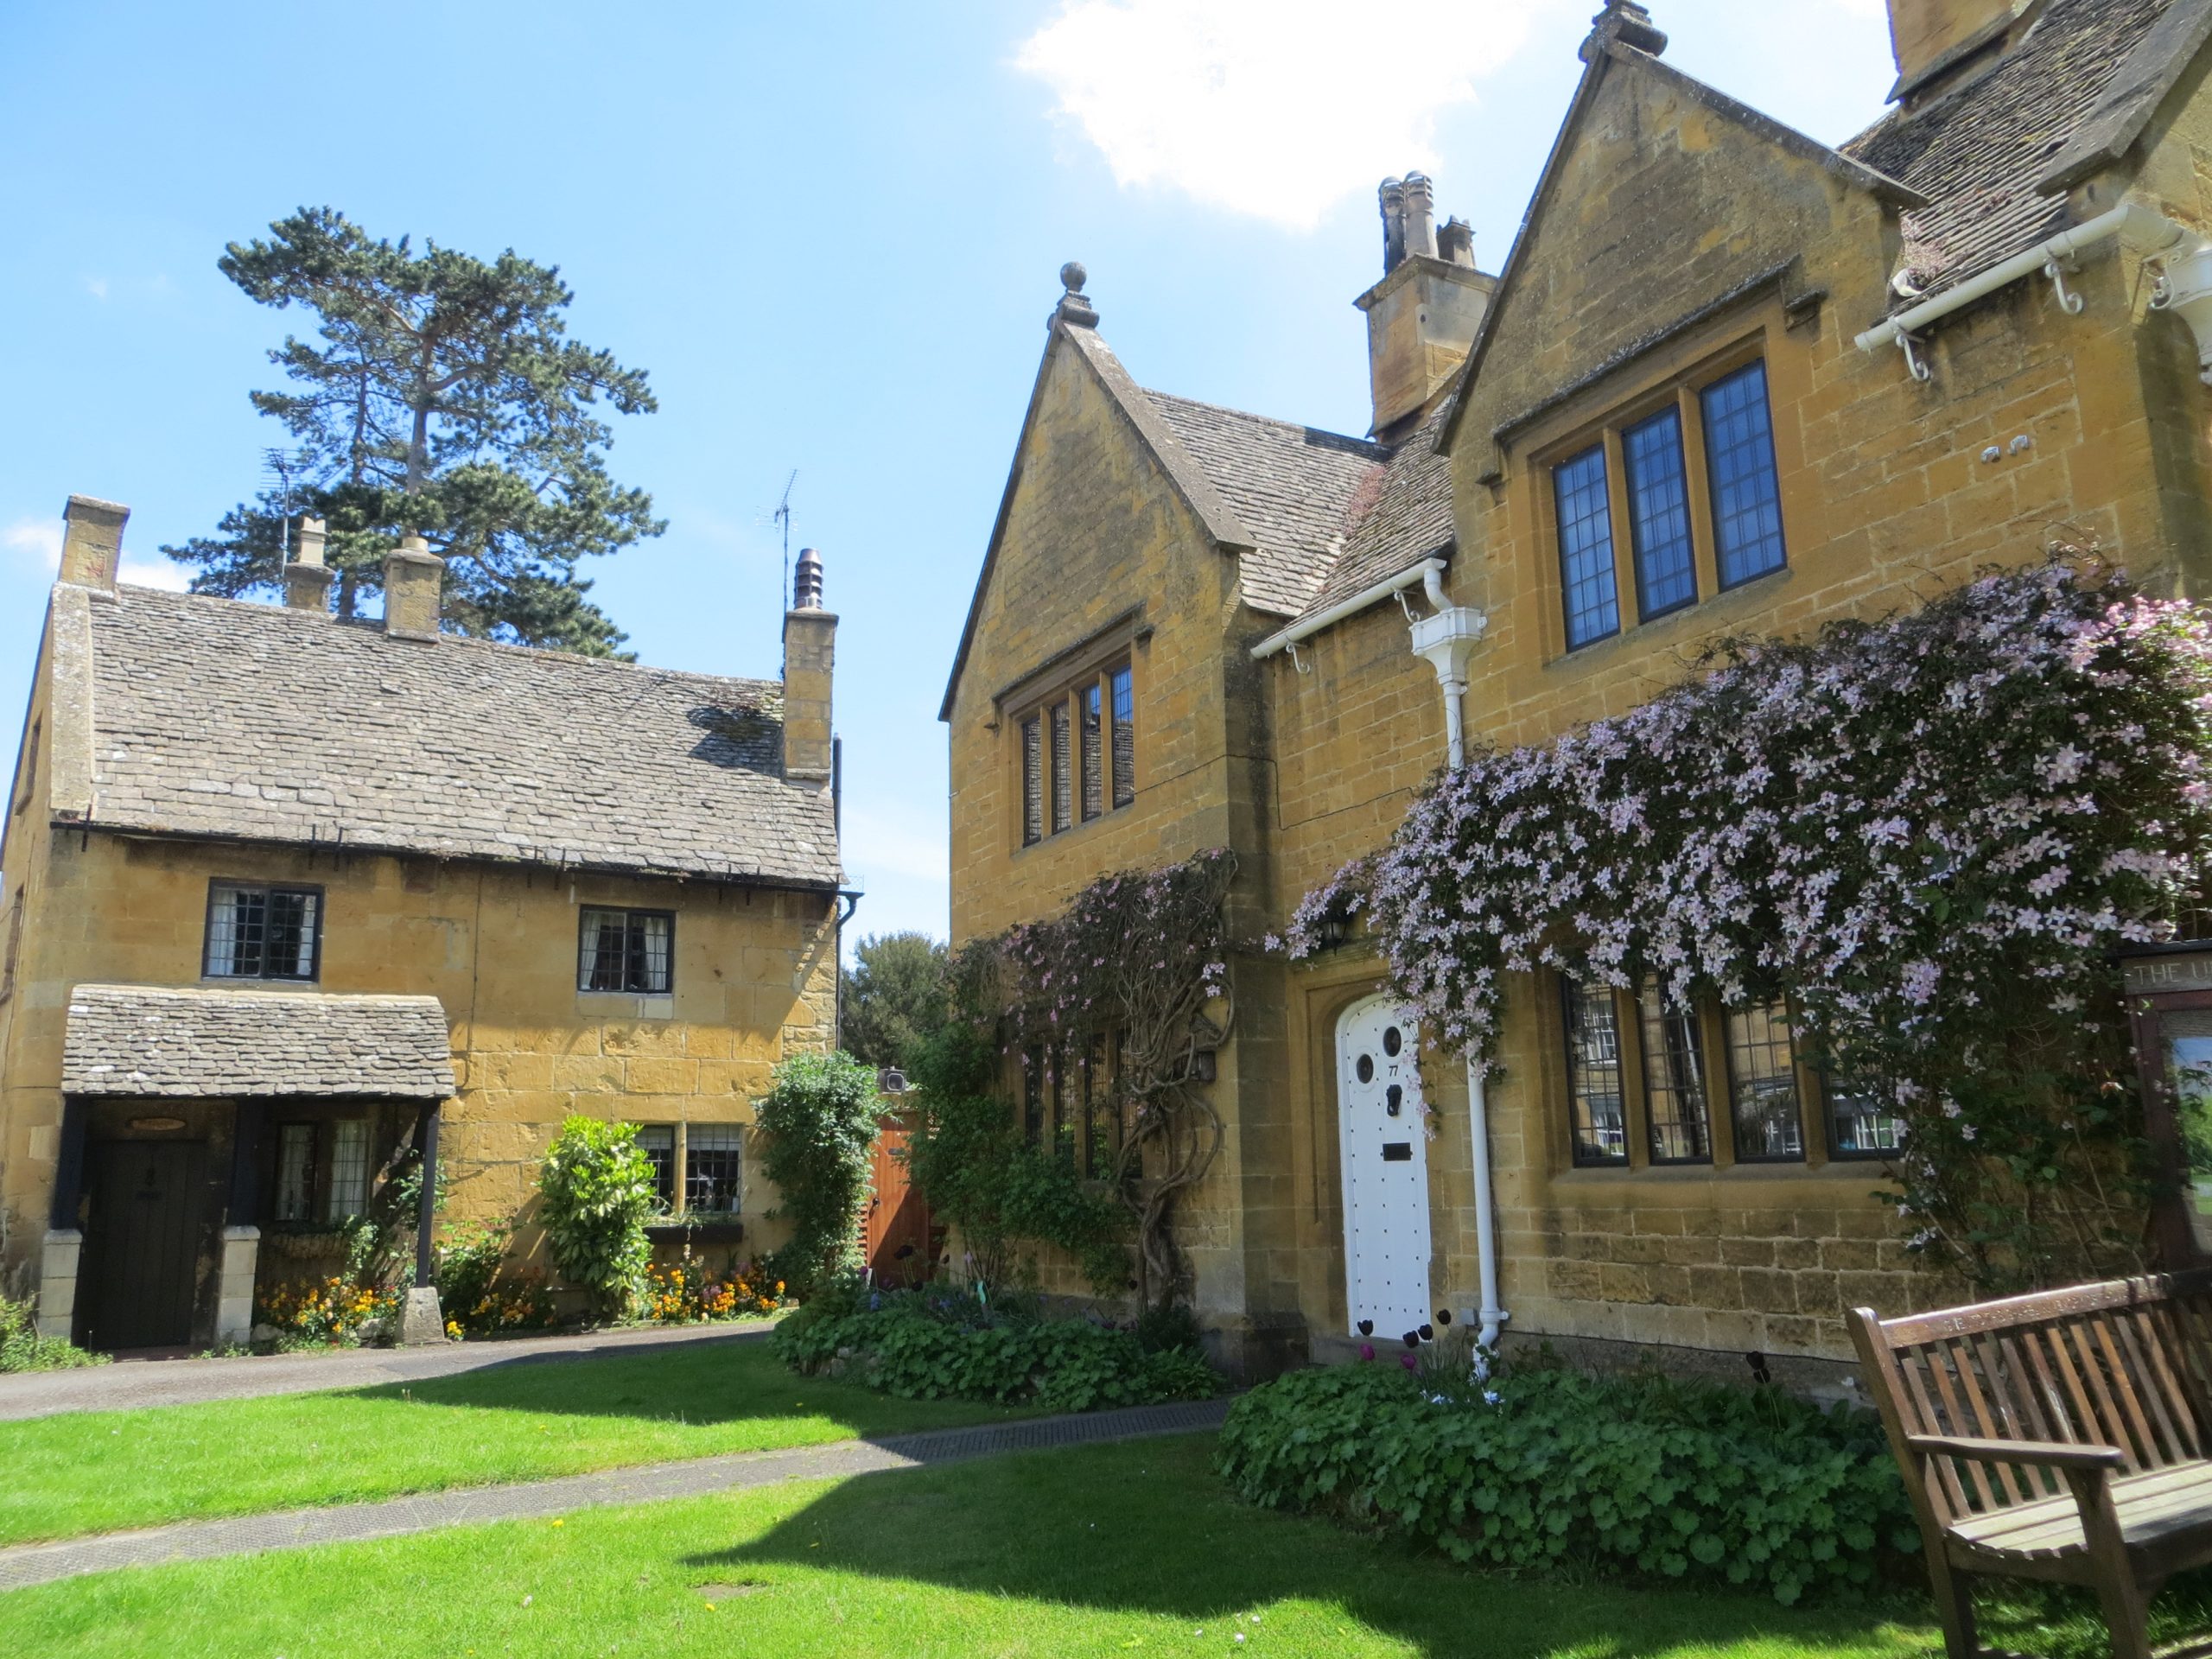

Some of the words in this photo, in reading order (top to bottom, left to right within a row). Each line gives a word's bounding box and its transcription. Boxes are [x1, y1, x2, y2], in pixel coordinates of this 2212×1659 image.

[2133, 963, 2181, 985] THE
[2191, 961, 2212, 981] U
[1389, 1065, 1398, 1077] 77
